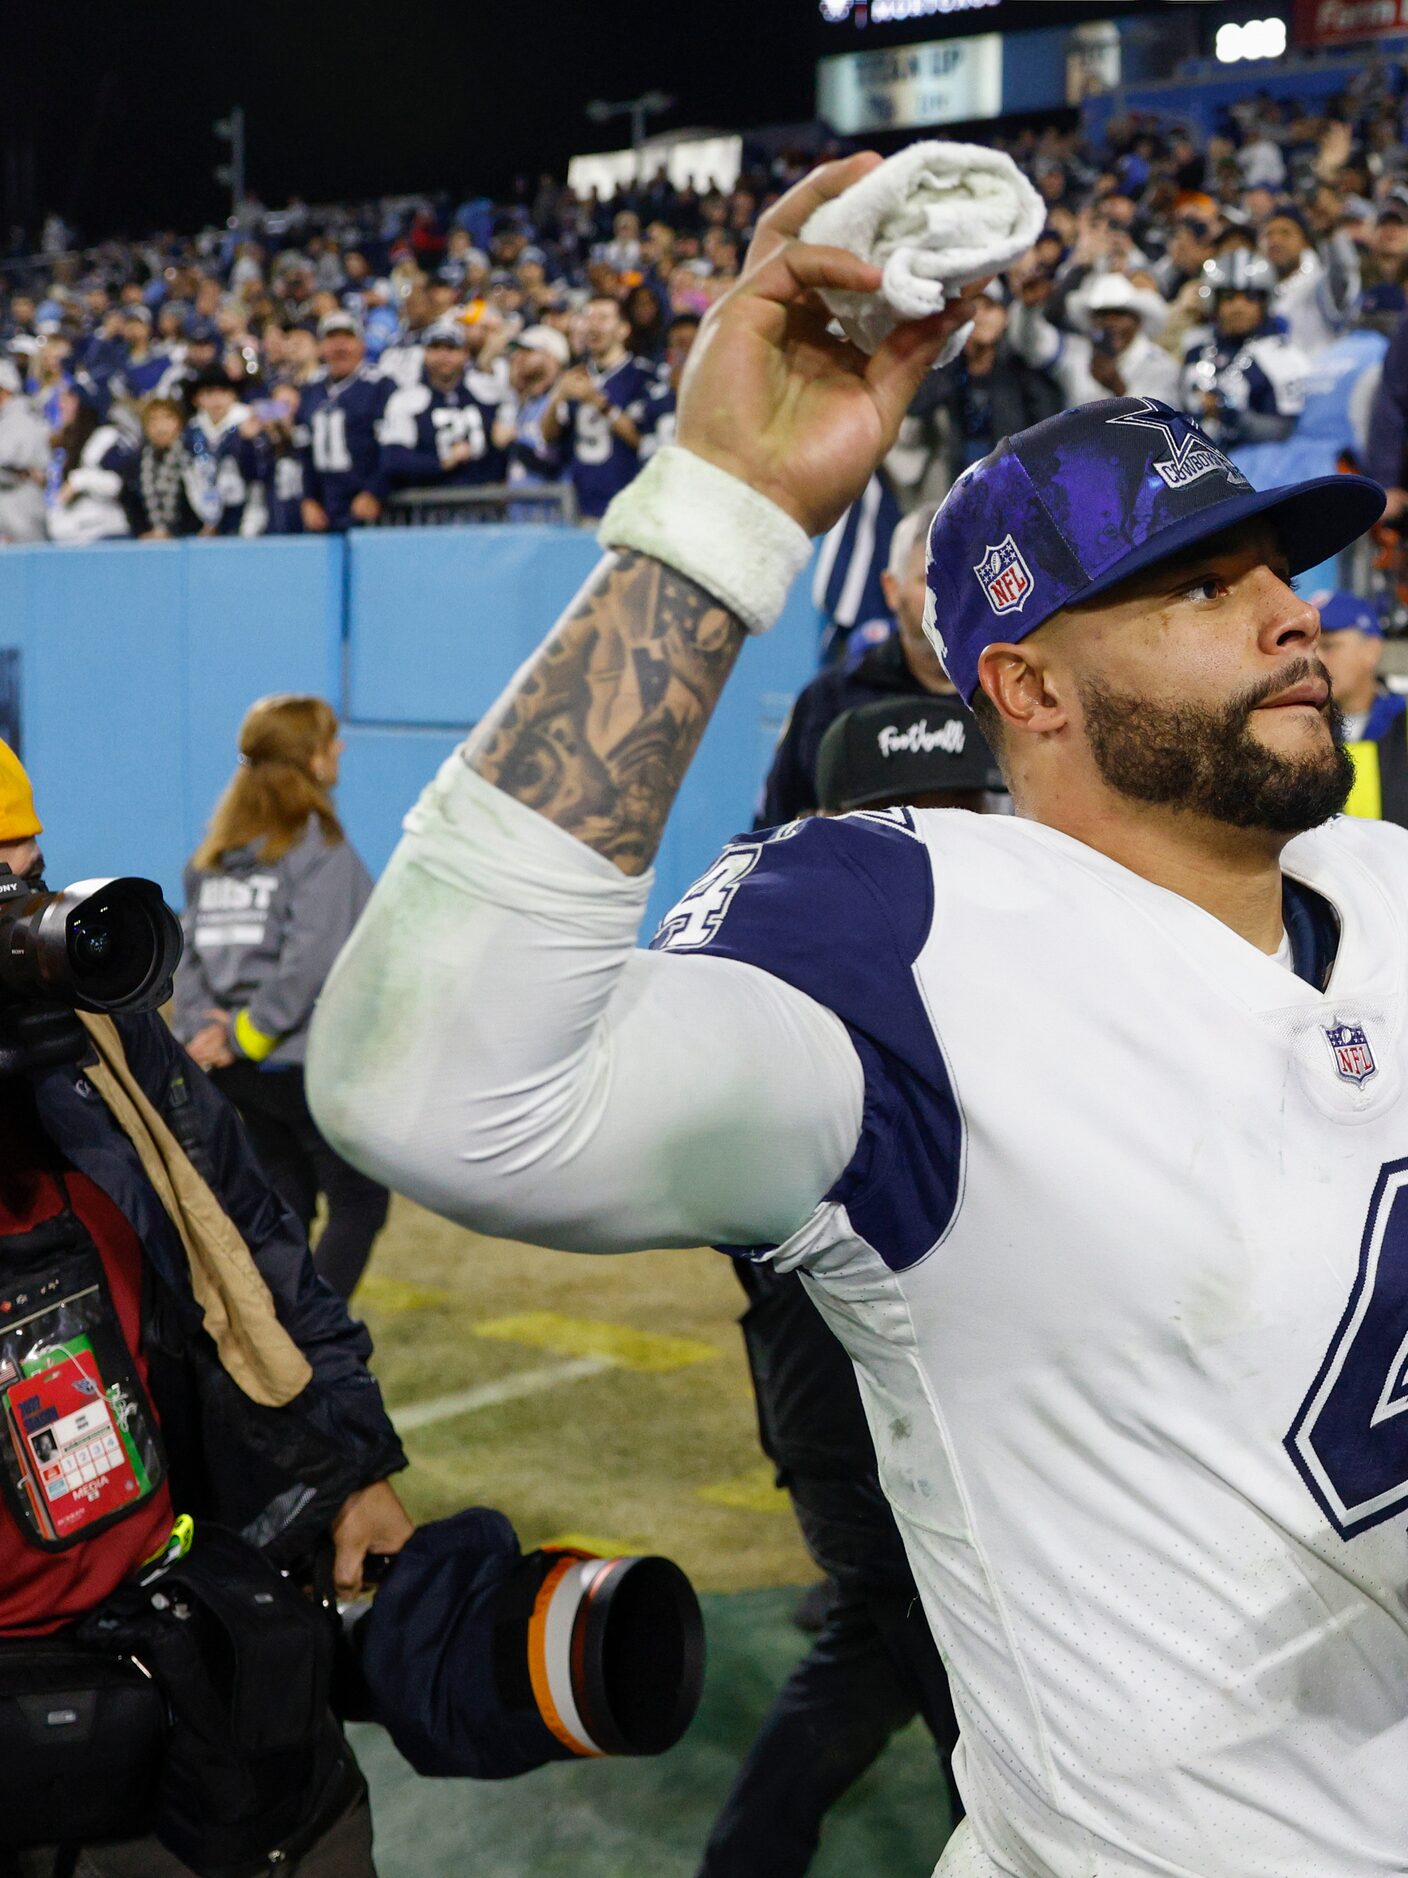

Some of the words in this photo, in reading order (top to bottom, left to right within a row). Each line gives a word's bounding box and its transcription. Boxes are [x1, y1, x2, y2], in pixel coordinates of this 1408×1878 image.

[312, 407, 353, 473] 11
[990, 566, 1026, 607] NFL
[660, 842, 763, 952] 4
[1338, 1047, 1372, 1075] NFL
[72, 1475, 110, 1501] MEDIA
